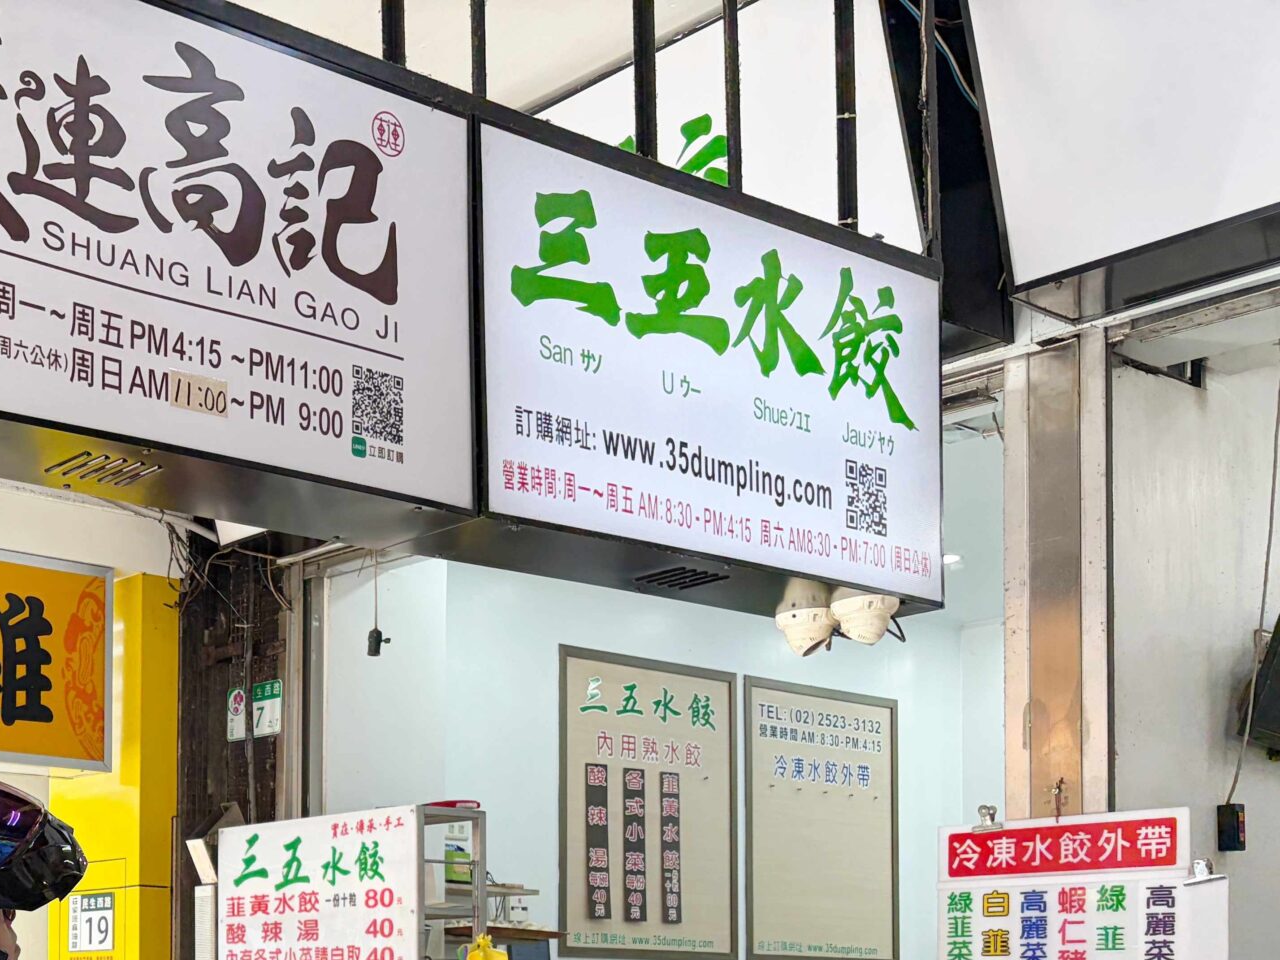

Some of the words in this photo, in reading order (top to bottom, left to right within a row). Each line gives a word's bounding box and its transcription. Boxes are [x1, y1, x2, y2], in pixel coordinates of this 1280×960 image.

[42, 220, 191, 288] SHUANG
[206, 266, 276, 310] LIAN
[293, 291, 360, 331] GAO
[376, 315, 400, 343] JI
[510, 189, 919, 432] 三五水餃
[539, 334, 574, 366] San
[662, 370, 674, 395] U
[298, 409, 344, 439] 9:00
[514, 404, 598, 451] 訂購網址:
[602, 428, 833, 510] www.35dumpling.com
[256, 706, 265, 729] 7
[578, 676, 717, 732] 三五水餃
[758, 723, 799, 742] 營業時間
[596, 730, 702, 769] 內用熟水餃
[774, 754, 870, 788] 冷凍水餃外帶
[587, 766, 608, 869] 酸辣湯
[625, 770, 645, 872] 各式小菜
[233, 832, 386, 892] 三五水餃
[951, 825, 1172, 871] 冷凍水餃外帶
[225, 890, 320, 918] 韮黃水餃
[364, 888, 394, 909] 80
[592, 889, 607, 904] 40
[85, 915, 109, 945] 19
[225, 919, 320, 945] 酸辣湯
[364, 918, 394, 939] 40
[630, 935, 714, 950] www.35dumpling.com
